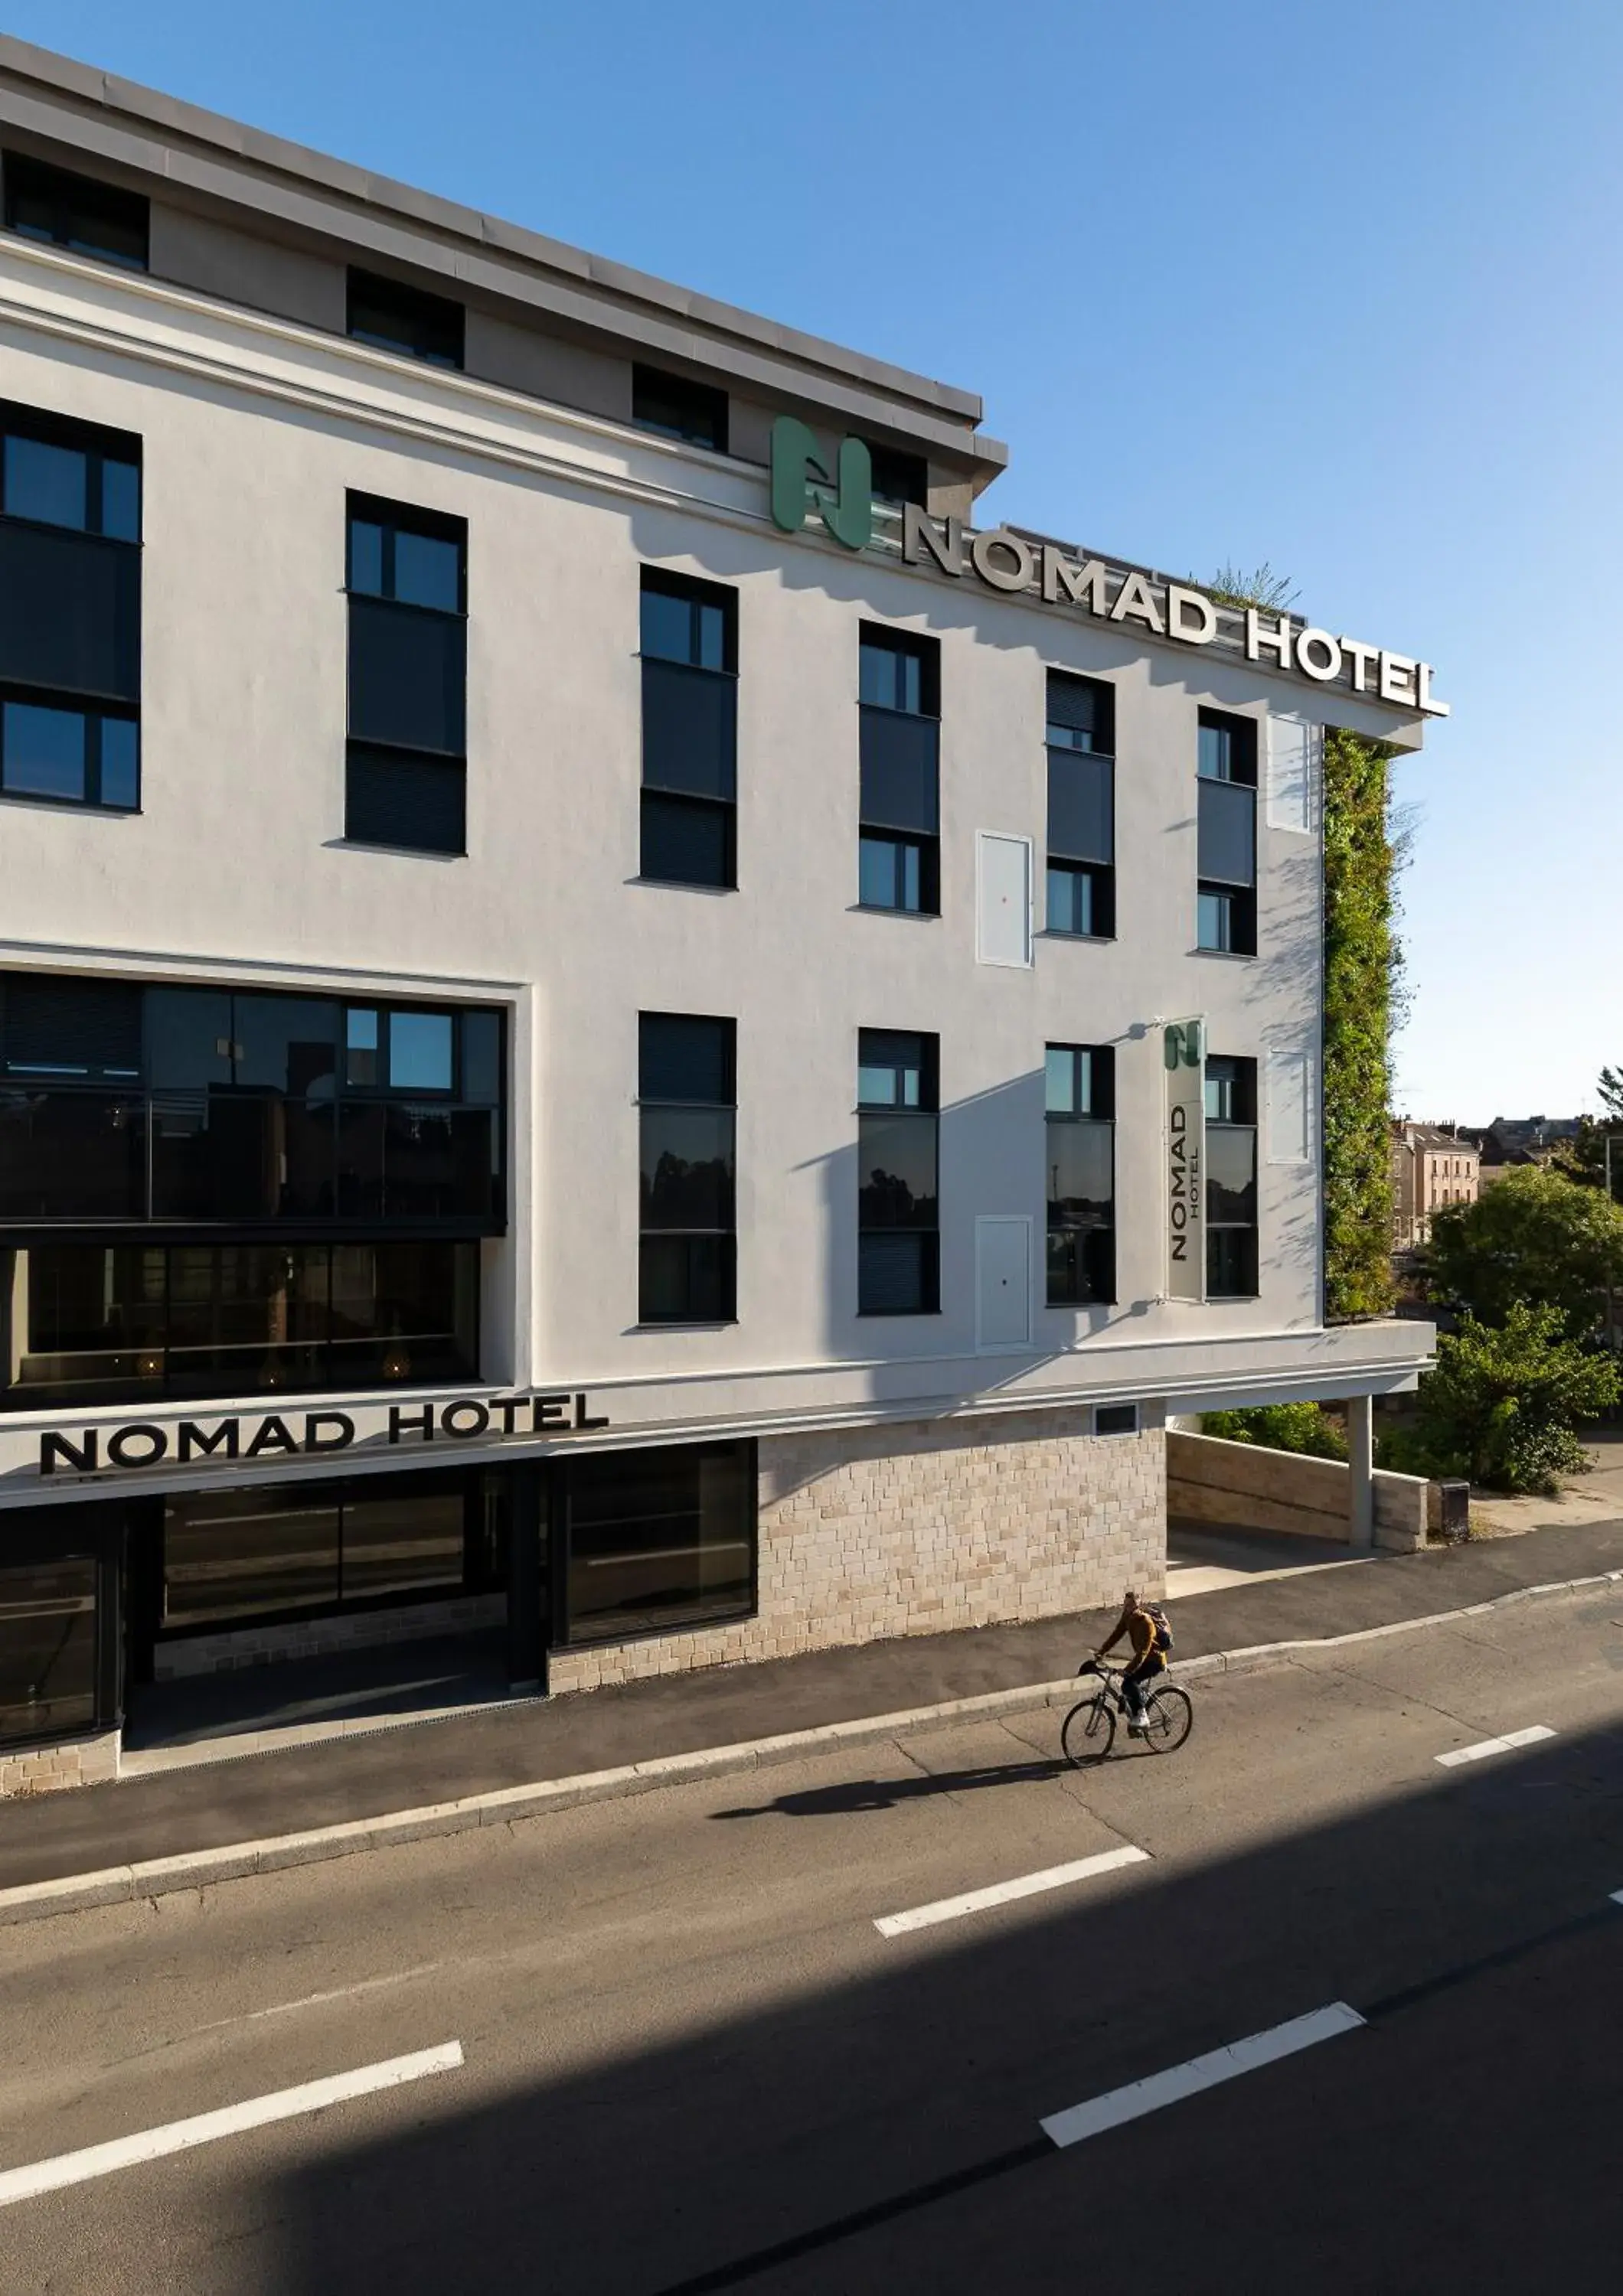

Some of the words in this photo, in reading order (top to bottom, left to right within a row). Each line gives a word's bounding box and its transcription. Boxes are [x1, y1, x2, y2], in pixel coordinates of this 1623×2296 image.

[902, 501, 1216, 647] NOMAD
[1246, 608, 1450, 717] HOTEL
[1171, 1104, 1187, 1261] NOMAD
[40, 1412, 355, 1475] NOMAD
[389, 1393, 609, 1444] HOTEL
